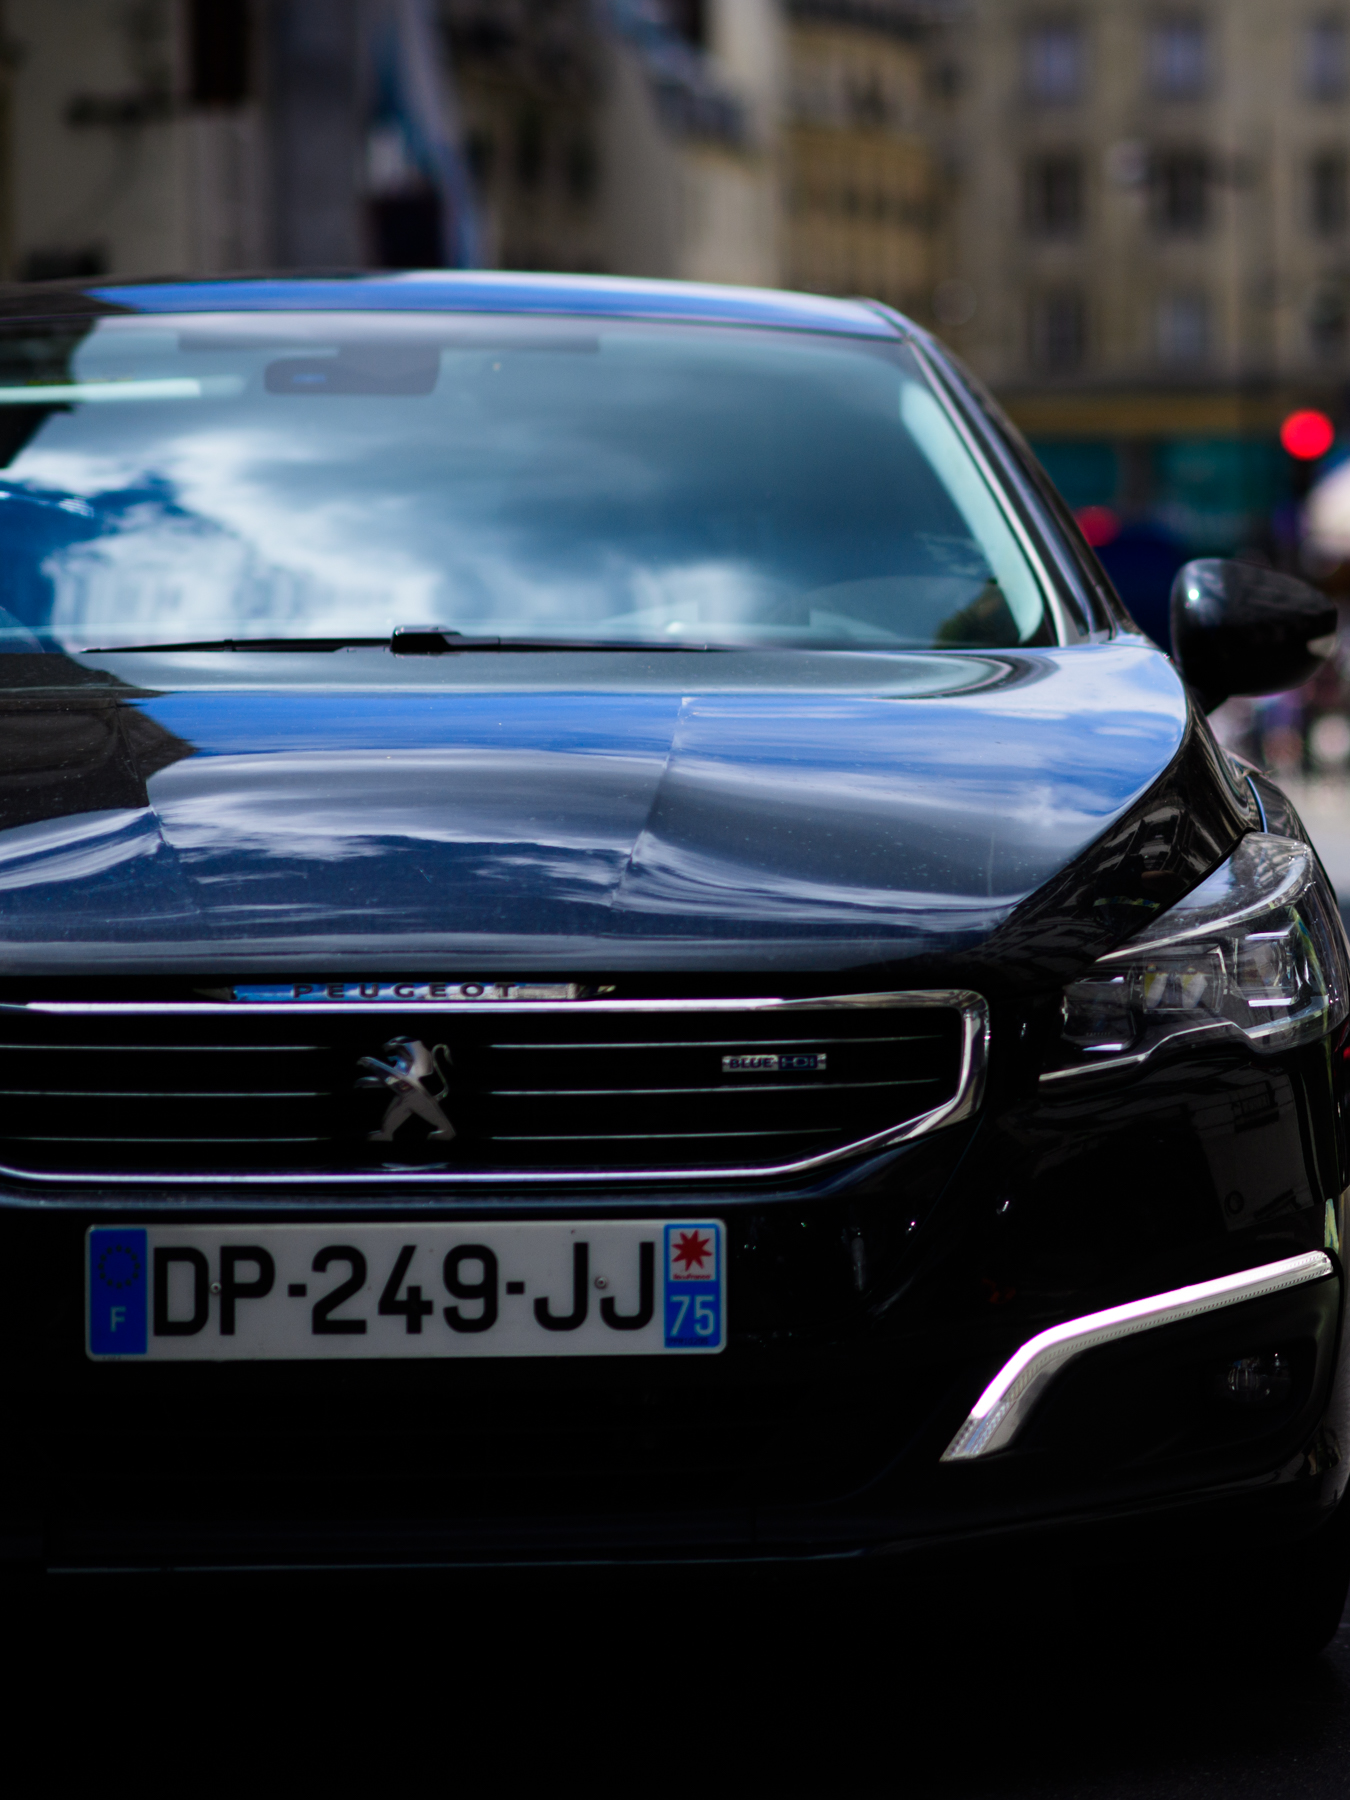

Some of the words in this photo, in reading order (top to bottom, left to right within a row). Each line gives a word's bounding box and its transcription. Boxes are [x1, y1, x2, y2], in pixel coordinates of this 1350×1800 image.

[293, 982, 517, 999] PEUGEOT
[729, 1057, 773, 1068] BLUE
[153, 1242, 655, 1336] DP-249-JJ
[110, 1305, 127, 1332] F
[670, 1294, 715, 1336] 75
